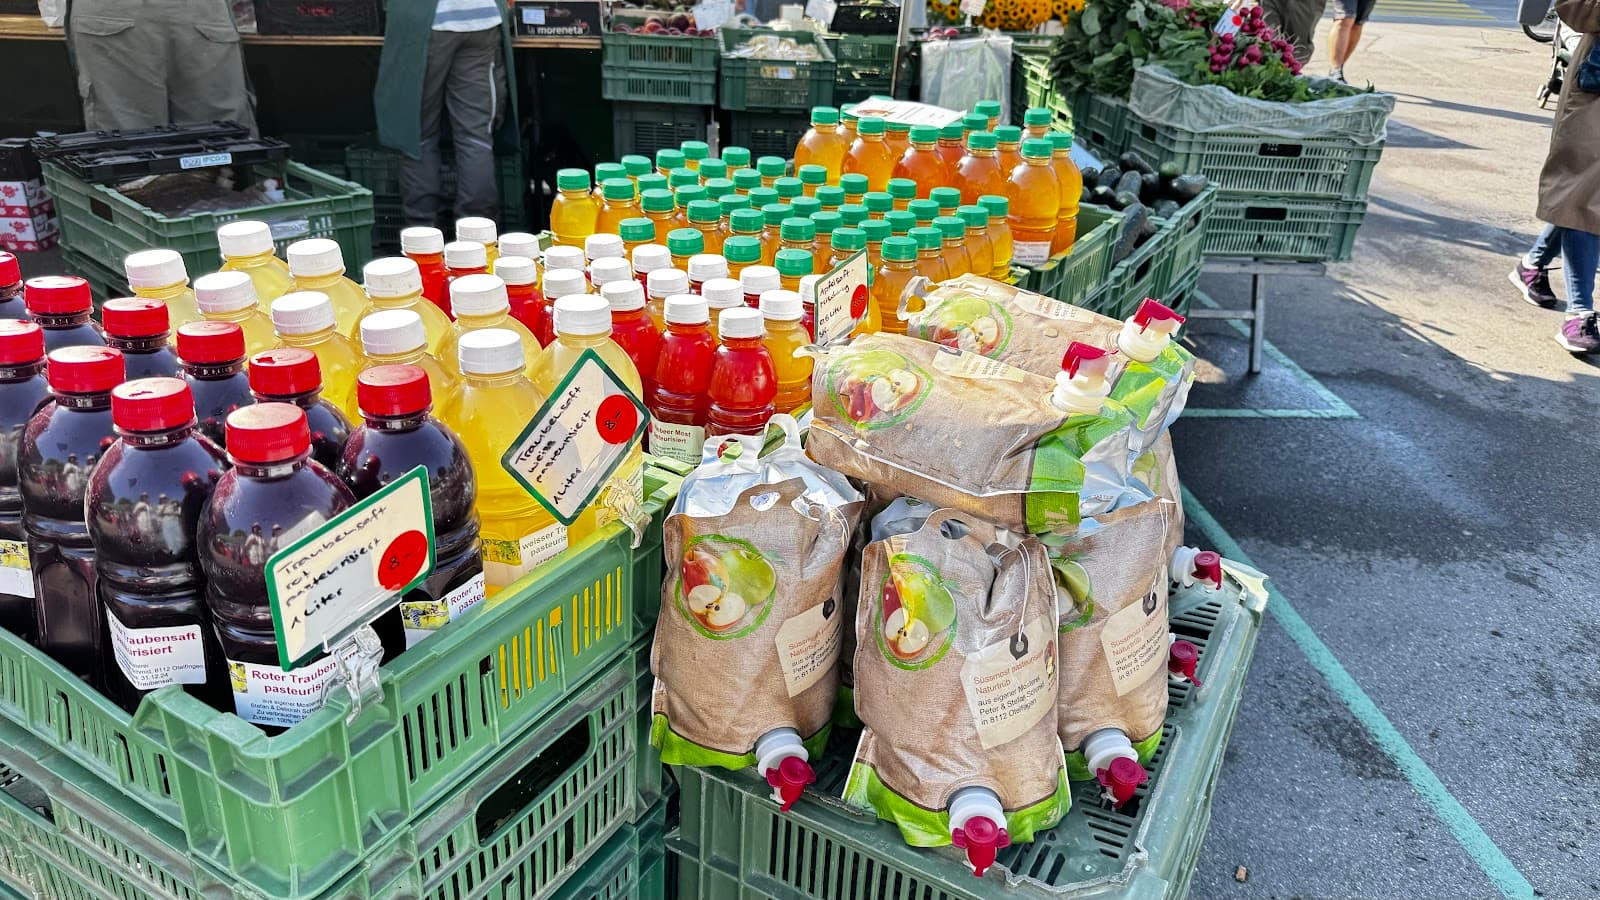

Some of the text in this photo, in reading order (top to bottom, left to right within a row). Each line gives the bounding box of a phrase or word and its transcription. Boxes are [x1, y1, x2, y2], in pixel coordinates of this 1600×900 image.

[537, 26, 584, 35] moreneta
[514, 386, 581, 465] Traubensaft
[675, 429, 691, 438] Most
[536, 410, 591, 483] pasteurisiert
[553, 467, 583, 505] 1 Liter
[278, 506, 387, 575] Traubensaft
[521, 531, 555, 550] weisser
[529, 535, 567, 557] pasteuris
[286, 538, 382, 608] pasteurisiert
[450, 586, 473, 606] Roter
[291, 587, 343, 630] 1 Liter
[251, 661, 337, 684] Roter Trauben
[1116, 661, 1132, 672] Peter
[1126, 665, 1140, 677] 8112
[978, 698, 992, 707] aus
[994, 688, 1017, 703] eigener
[979, 706, 1000, 716] Peter
[981, 718, 988, 726] in
[990, 713, 1008, 723] 8112
